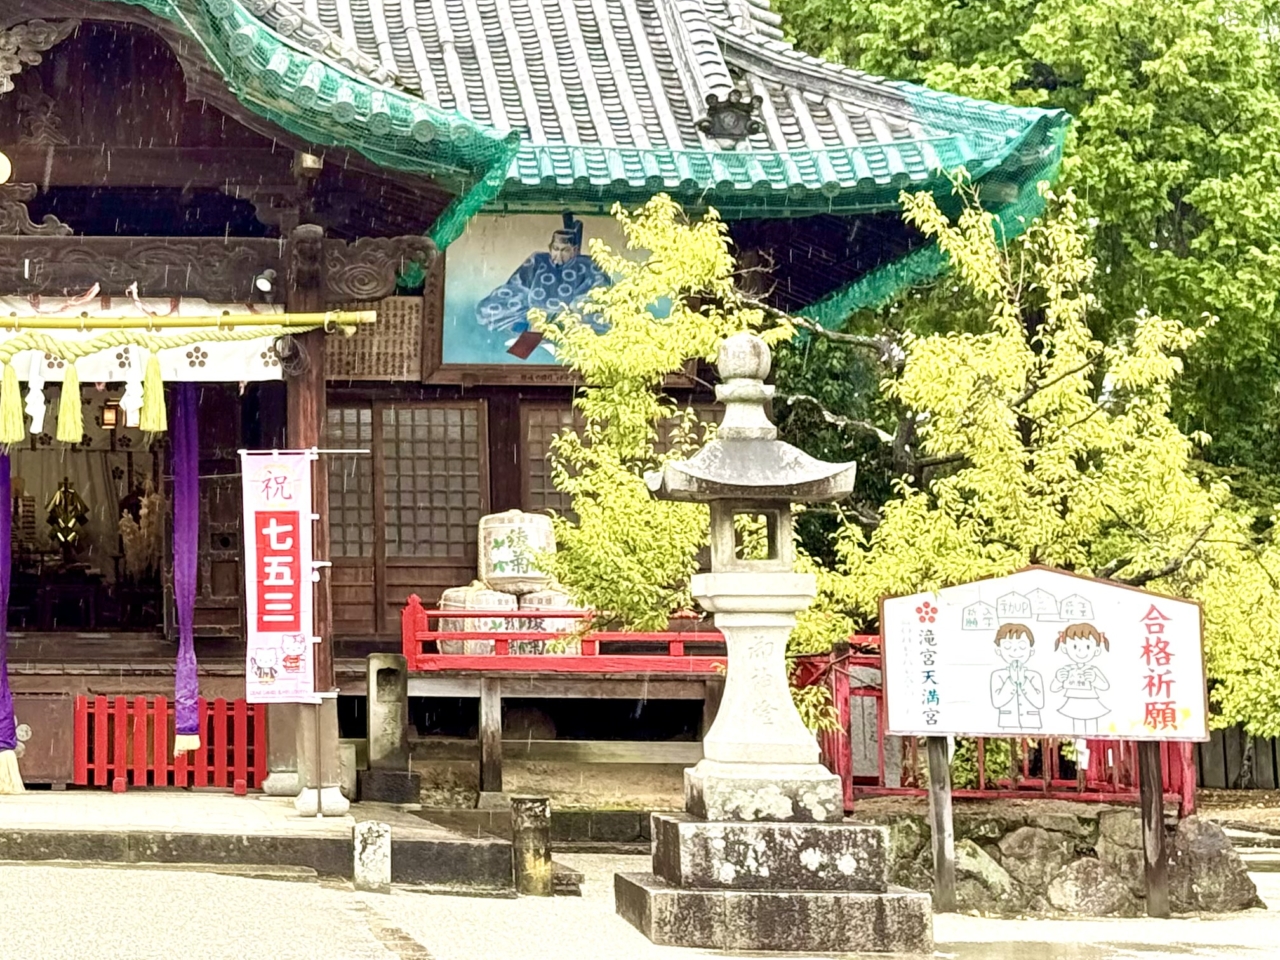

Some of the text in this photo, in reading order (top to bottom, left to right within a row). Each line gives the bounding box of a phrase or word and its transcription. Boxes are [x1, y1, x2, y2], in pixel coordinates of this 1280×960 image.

[261, 470, 294, 501] 祝
[261, 518, 295, 622] 七五三
[919, 629, 941, 726] 滝宮天満宮
[1139, 603, 1178, 730] 合格祈願
